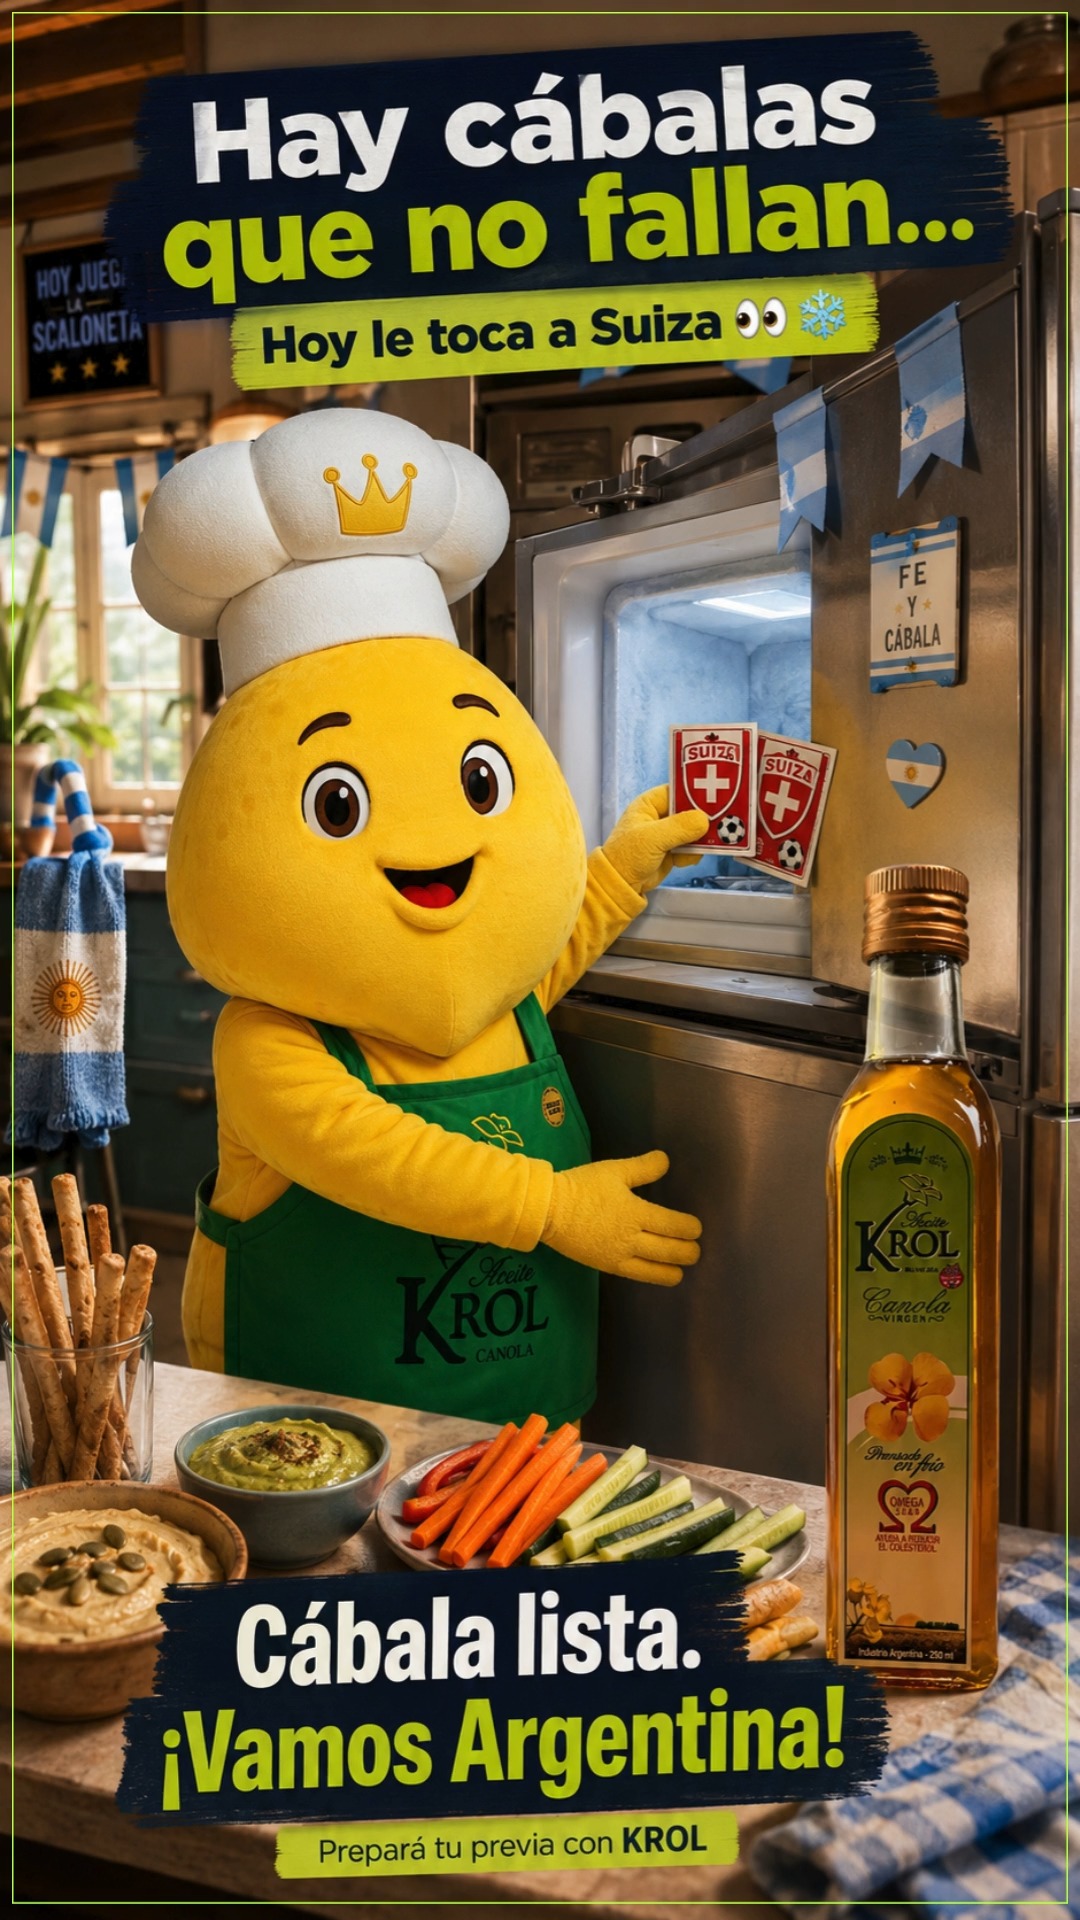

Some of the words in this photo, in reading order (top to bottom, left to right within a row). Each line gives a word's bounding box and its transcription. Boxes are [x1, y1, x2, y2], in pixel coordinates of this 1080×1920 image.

[36, 266, 71, 299] HOY
[76, 258, 126, 293] JUEG
[66, 298, 83, 313] LA
[32, 309, 143, 353] SCALONETA
[899, 561, 927, 589] FE
[907, 595, 917, 617] Y
[885, 623, 941, 652] CÁBALA
[765, 758, 814, 783] SUIZA
[854, 1200, 961, 1272] KROL
[468, 1255, 536, 1287] Aceite
[395, 1243, 549, 1364] KROL
[863, 1286, 951, 1314] Canola
[884, 1315, 926, 1323] VIRGEN
[475, 1343, 534, 1363] CANOLA
[894, 1461, 913, 1471] en
[890, 1496, 924, 1507] OMEGA
